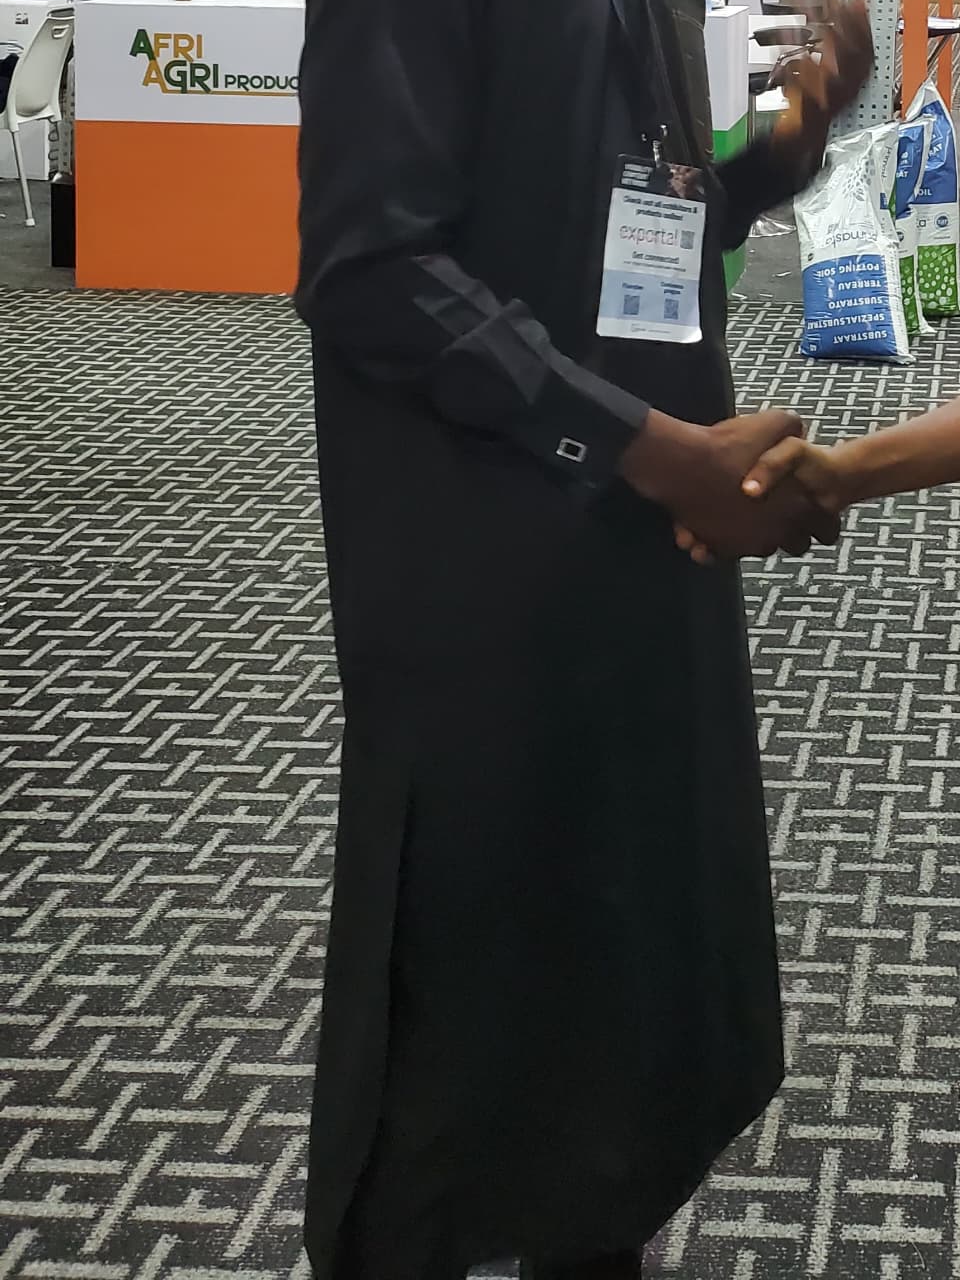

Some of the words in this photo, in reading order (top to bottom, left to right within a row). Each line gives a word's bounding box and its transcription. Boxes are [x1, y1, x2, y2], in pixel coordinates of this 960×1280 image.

[129, 28, 203, 62] AFRI
[142, 59, 219, 94] AGRI
[917, 187, 933, 197] OIL
[619, 224, 679, 247] exportal
[839, 263, 880, 275] POTTING
[838, 279, 882, 291] TERREAU
[828, 296, 883, 310] SUBSTRATO
[833, 330, 888, 344] SUBSTRAAT
